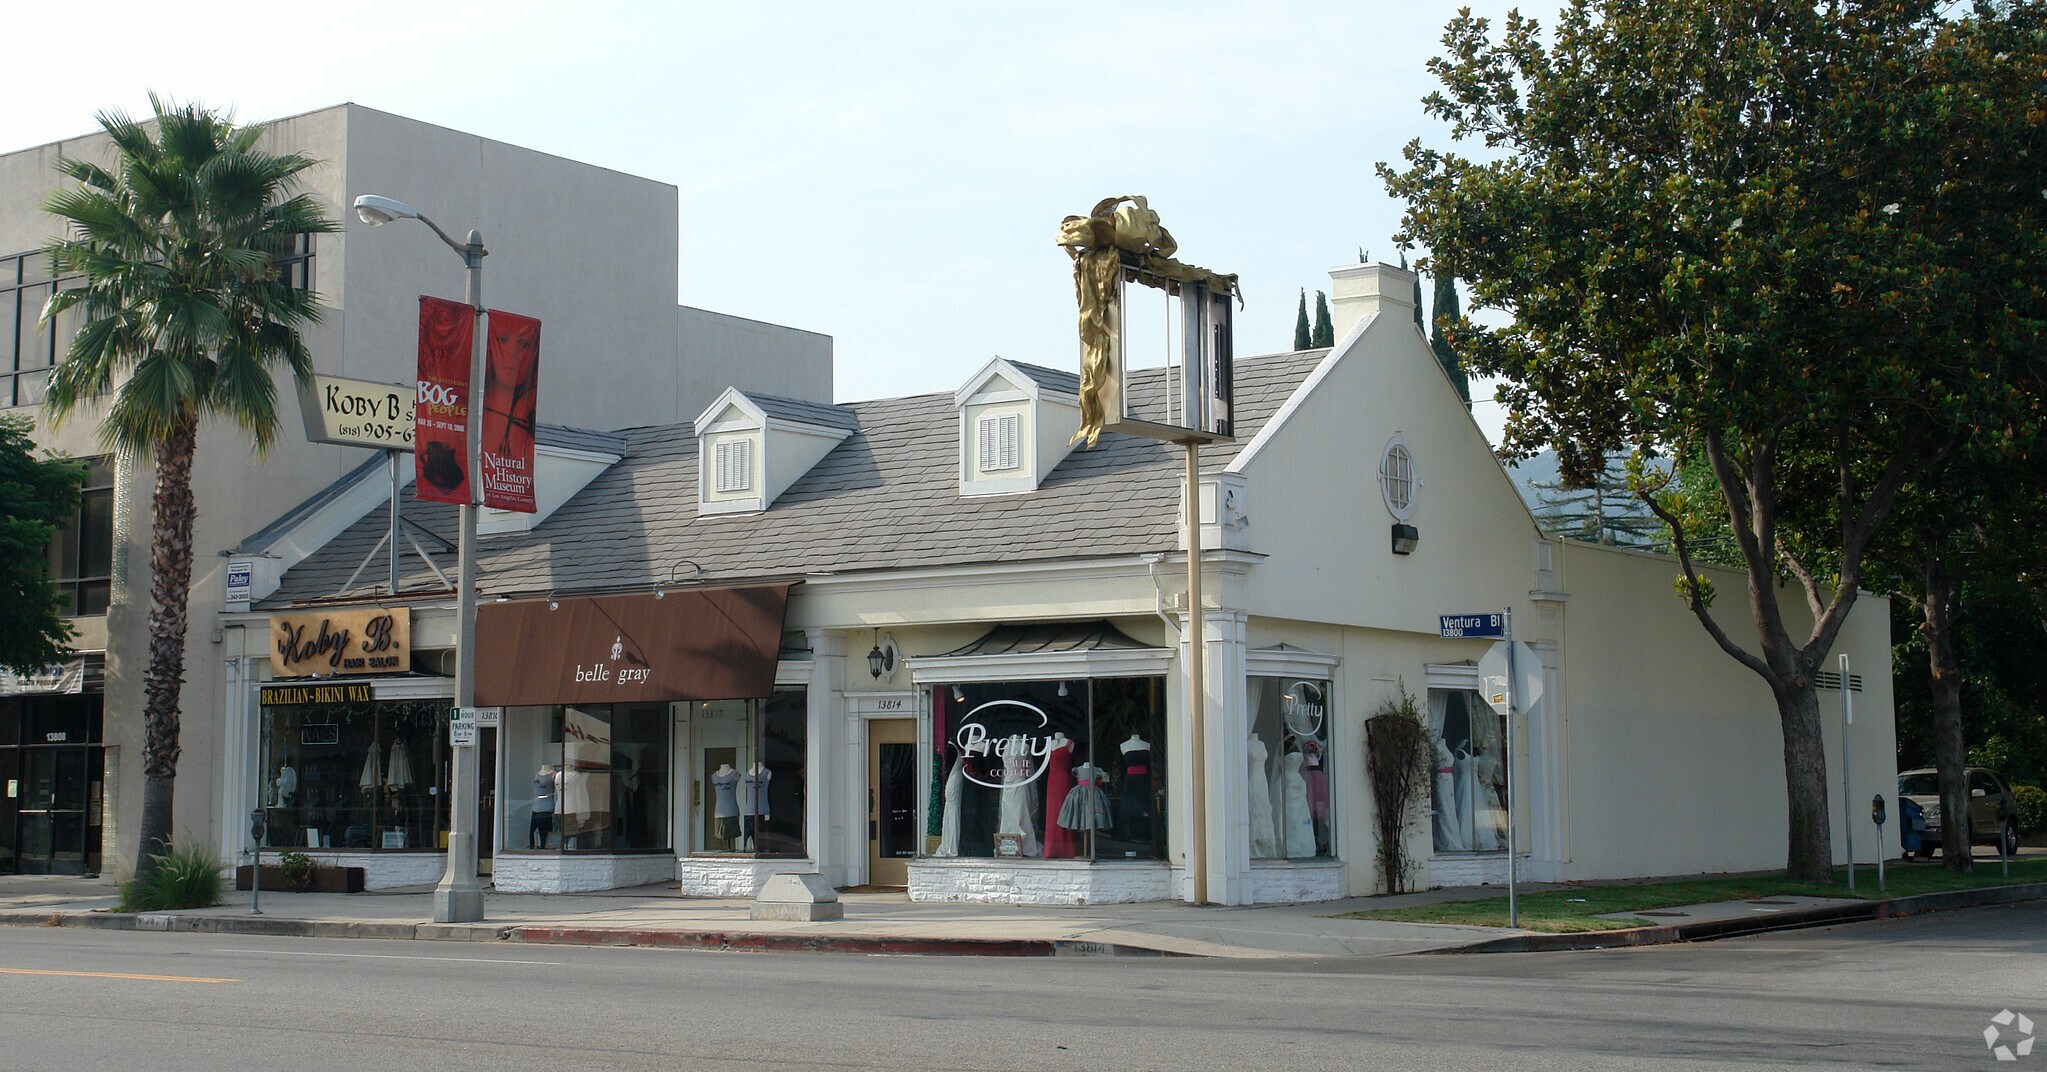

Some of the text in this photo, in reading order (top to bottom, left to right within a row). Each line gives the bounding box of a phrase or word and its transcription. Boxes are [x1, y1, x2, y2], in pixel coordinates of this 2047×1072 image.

[417, 380, 458, 406] BOG
[386, 393, 400, 421] B
[427, 403, 468, 417] PEOPLE
[339, 422, 416, 442] (818) 905-6
[436, 421, 447, 429] SEPT
[483, 451, 525, 470] Natural
[484, 473, 525, 494] Museum
[496, 467, 532, 488] History
[1443, 616, 1481, 629] Ventura
[278, 615, 399, 667] Koby B.
[1443, 628, 1463, 637] 13800
[343, 656, 399, 669] HAIR SALON
[575, 663, 651, 685] belle gray
[349, 685, 370, 702] WAX
[453, 709, 458, 719] 1
[878, 700, 902, 709] 13814
[1286, 693, 1323, 718] Pretty
[957, 723, 1052, 760] Pretty
